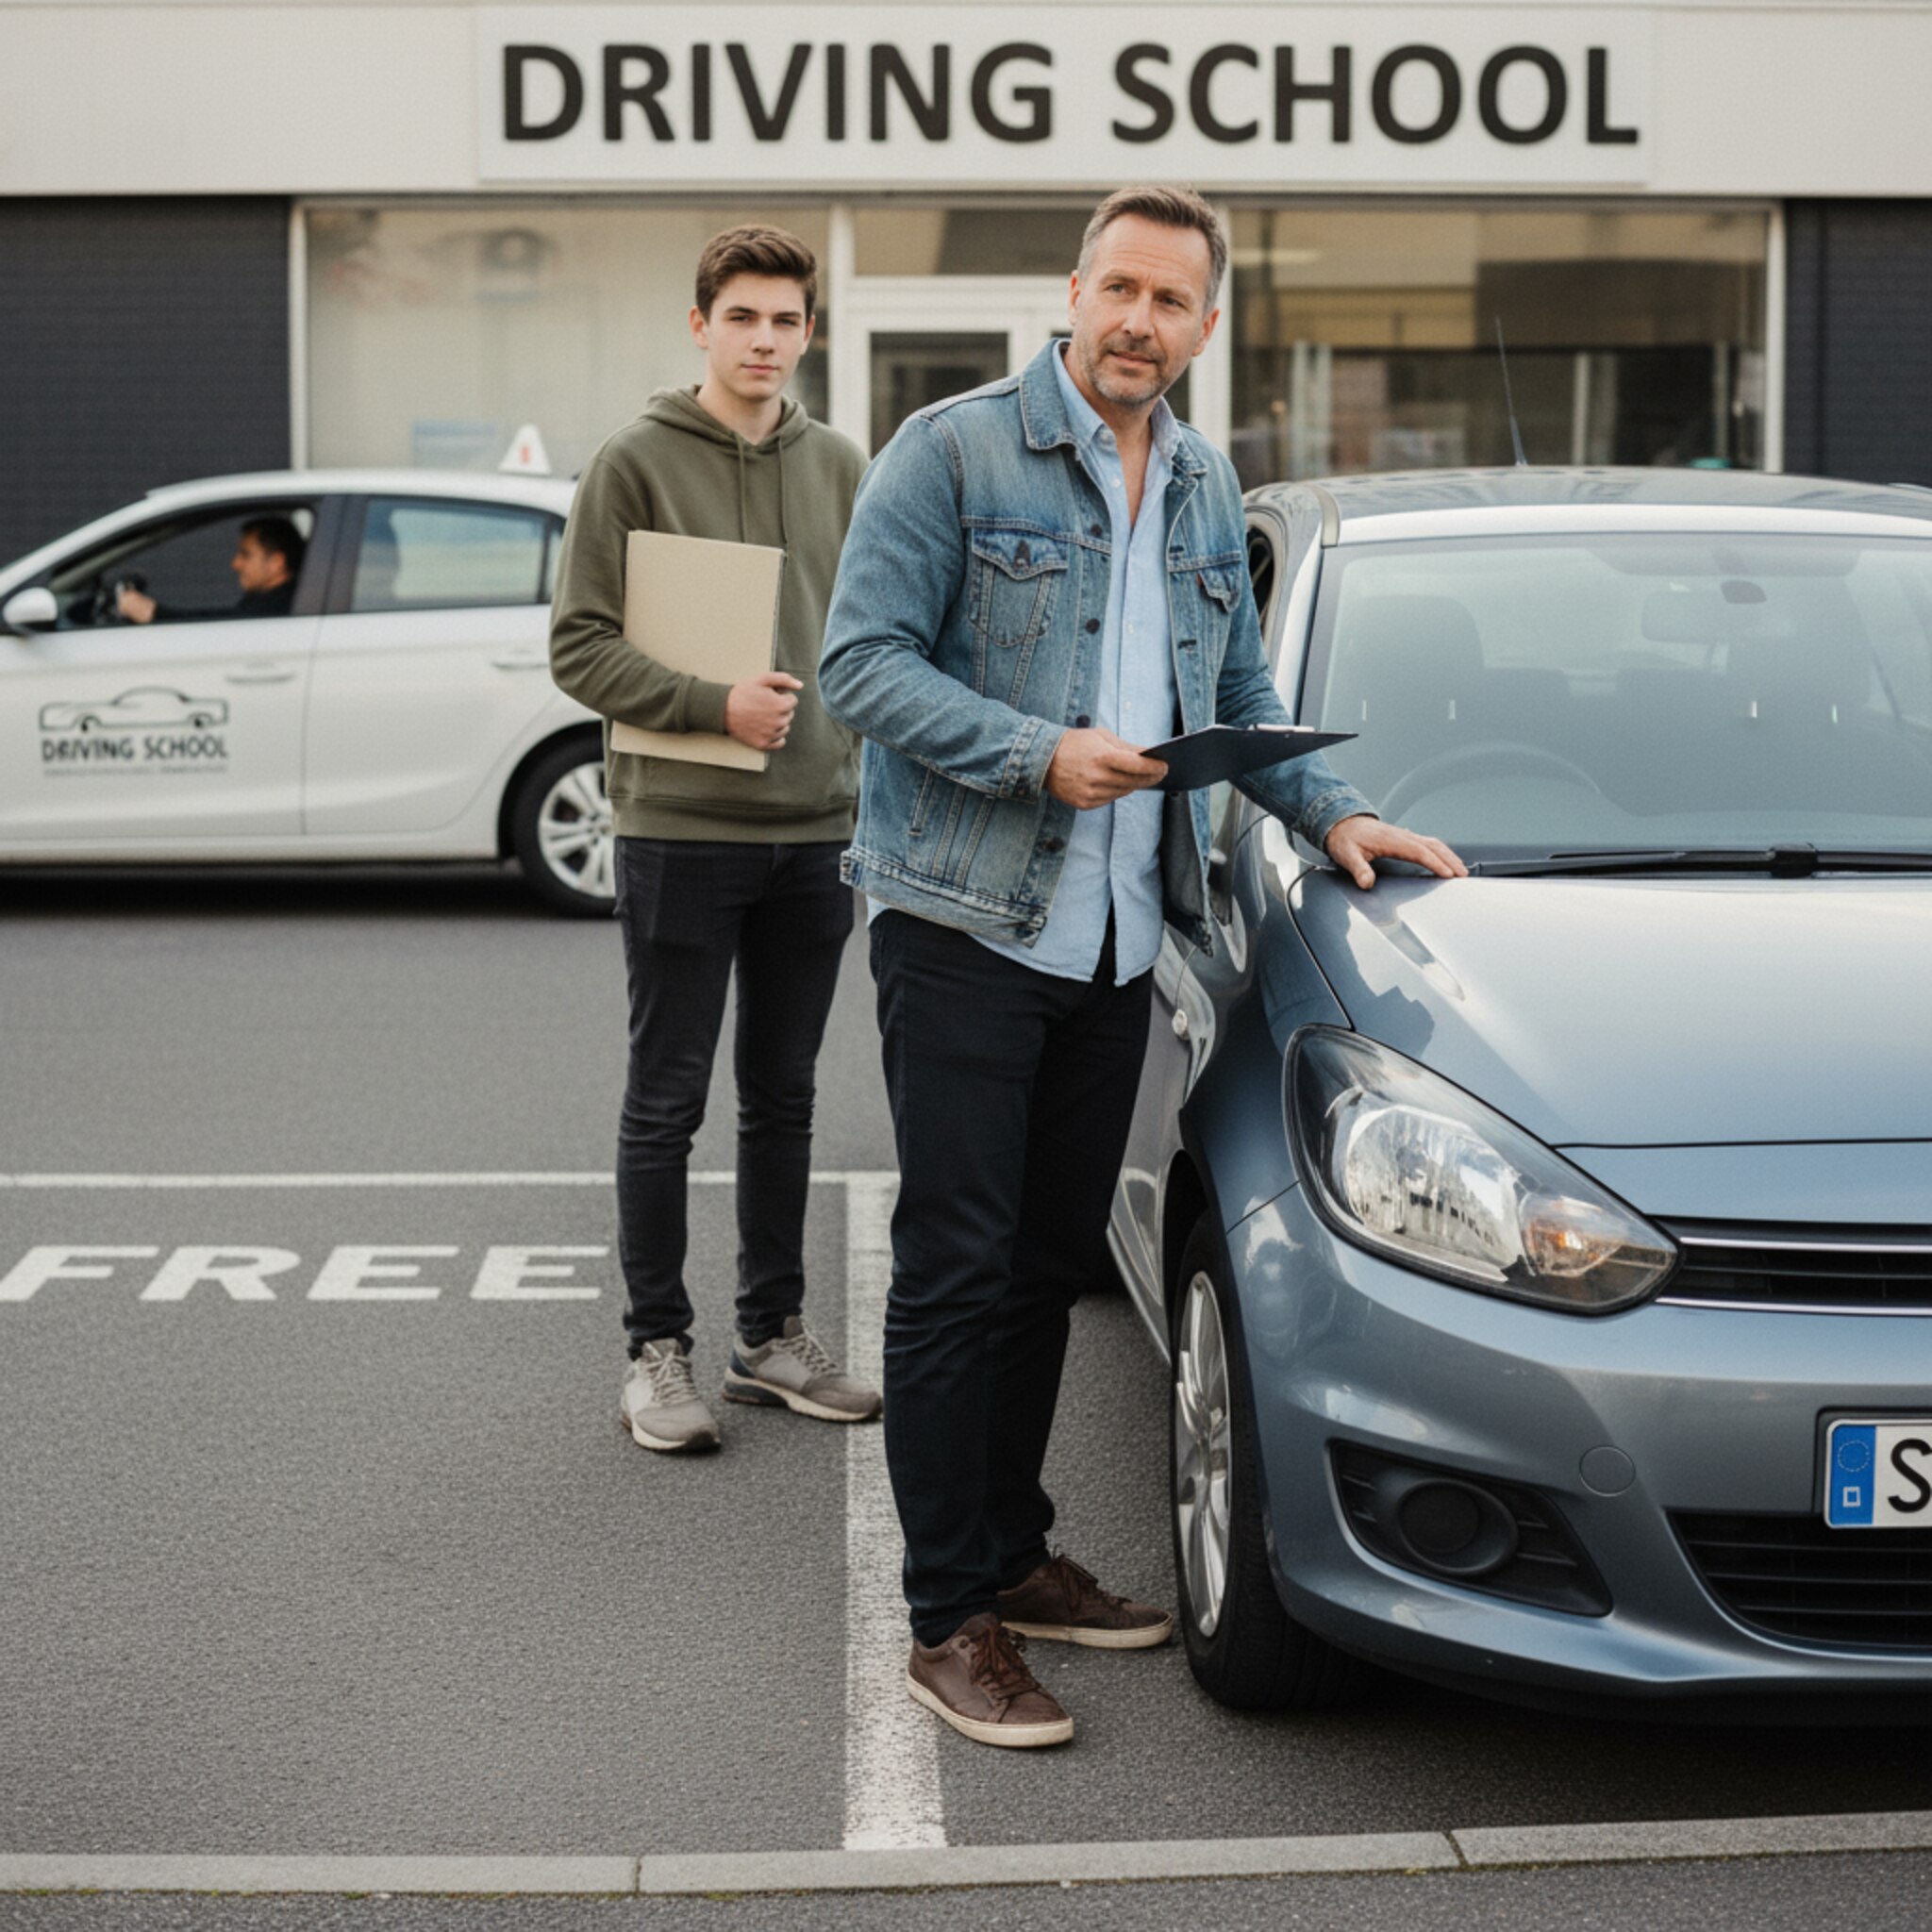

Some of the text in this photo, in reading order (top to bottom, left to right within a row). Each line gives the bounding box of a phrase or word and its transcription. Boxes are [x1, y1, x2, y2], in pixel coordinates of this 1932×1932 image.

[502, 42, 1641, 145] DRIVING SCHOOL
[42, 735, 228, 761] DRIVING SCHOOL
[0, 1245, 609, 1301] FREE
[1887, 1438, 1932, 1514] S
